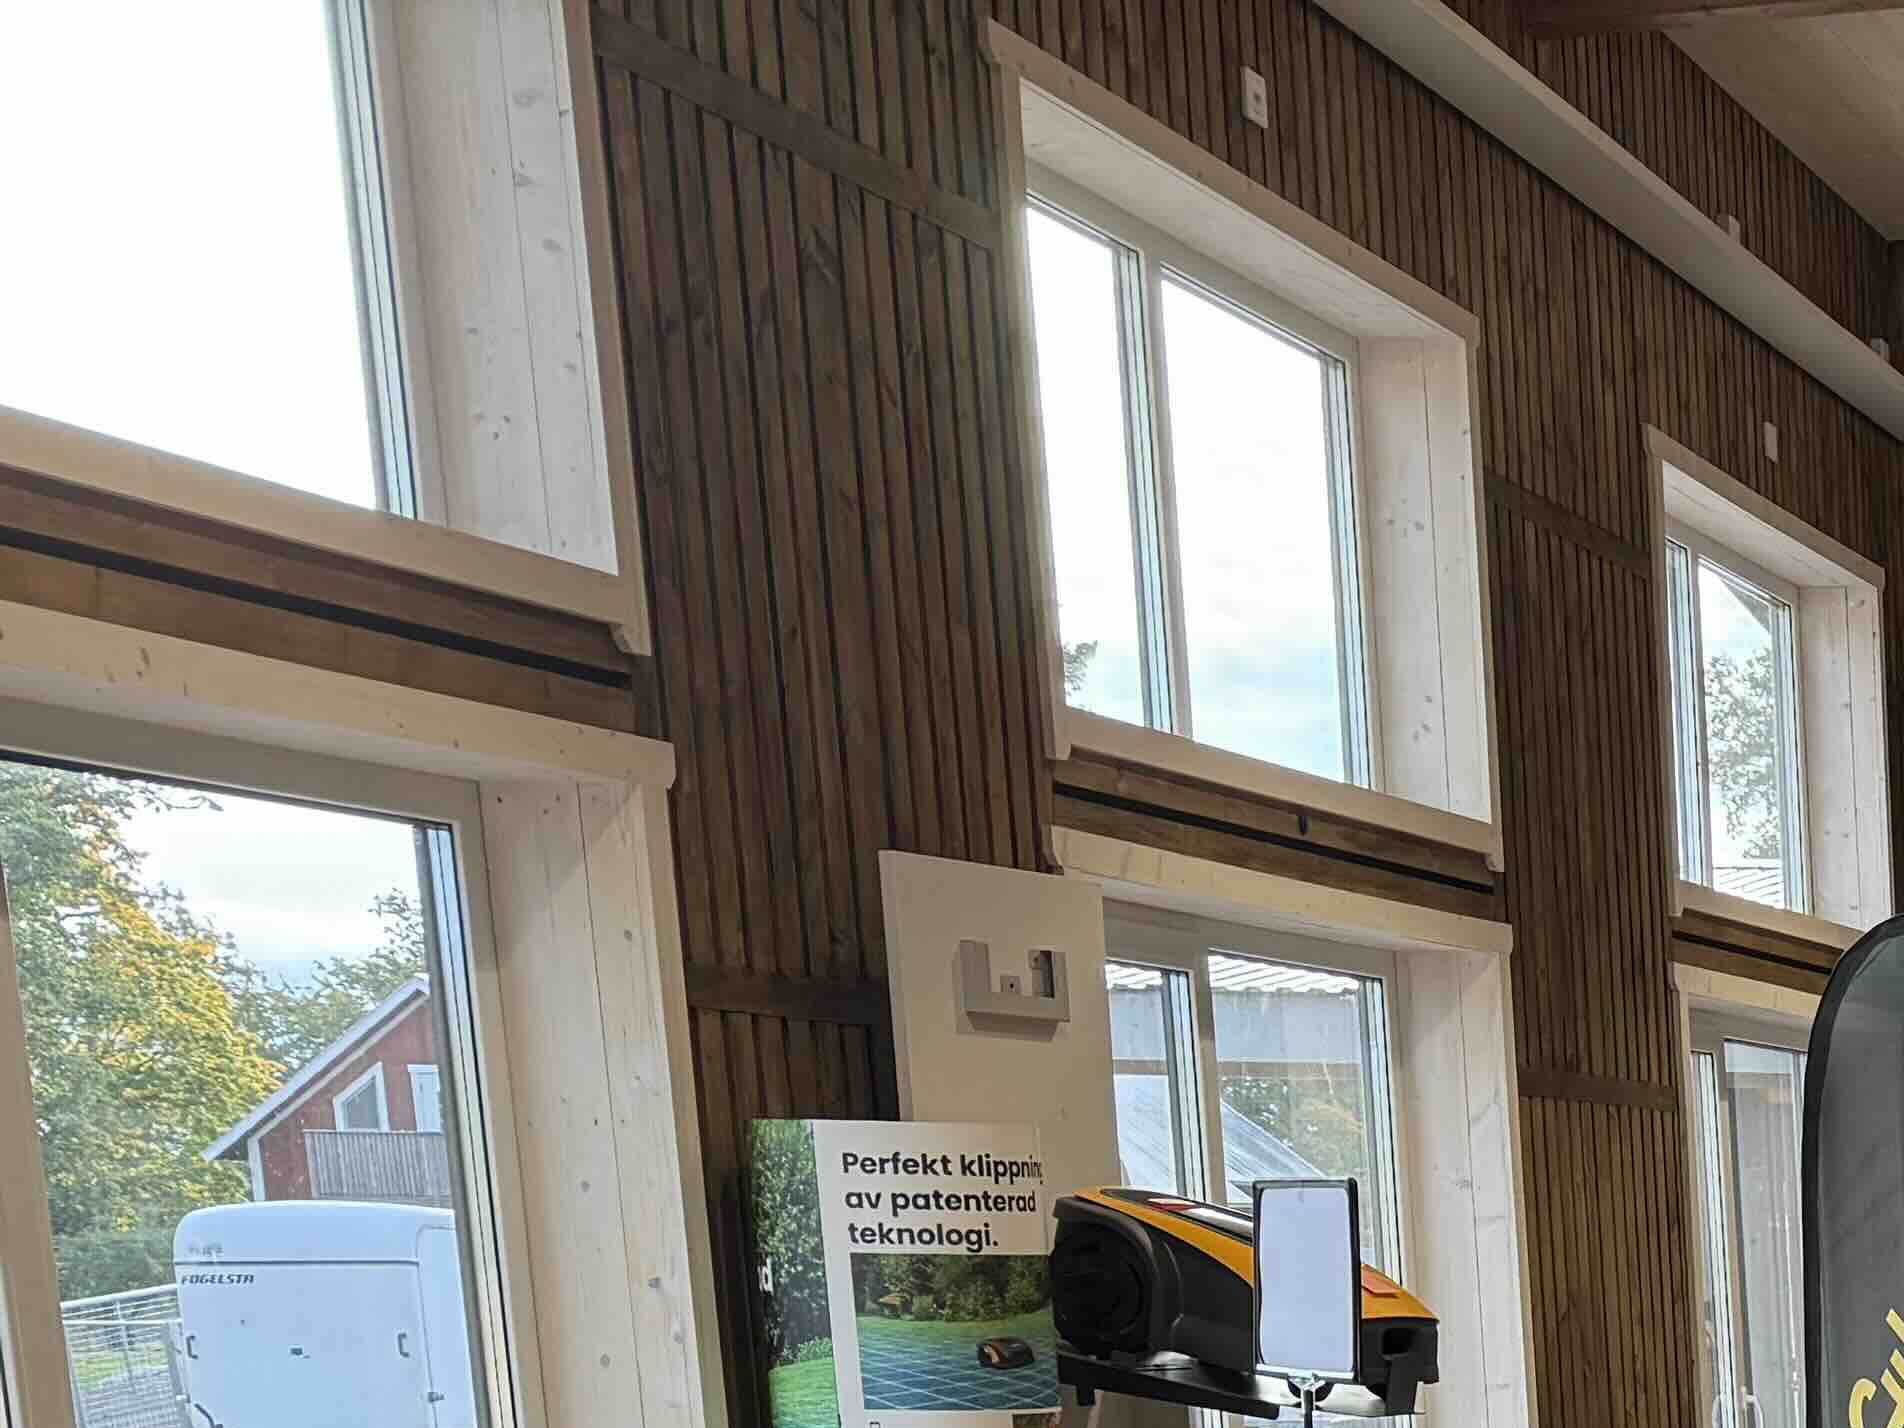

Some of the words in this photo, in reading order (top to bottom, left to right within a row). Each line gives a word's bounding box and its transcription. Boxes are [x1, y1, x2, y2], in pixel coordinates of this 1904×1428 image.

[842, 1151, 952, 1176] Perfekt
[845, 1191, 882, 1209] av
[891, 1190, 1036, 1217] patenterad
[848, 1222, 999, 1253] teknologi.
[181, 1273, 255, 1285] FOGELSTA
